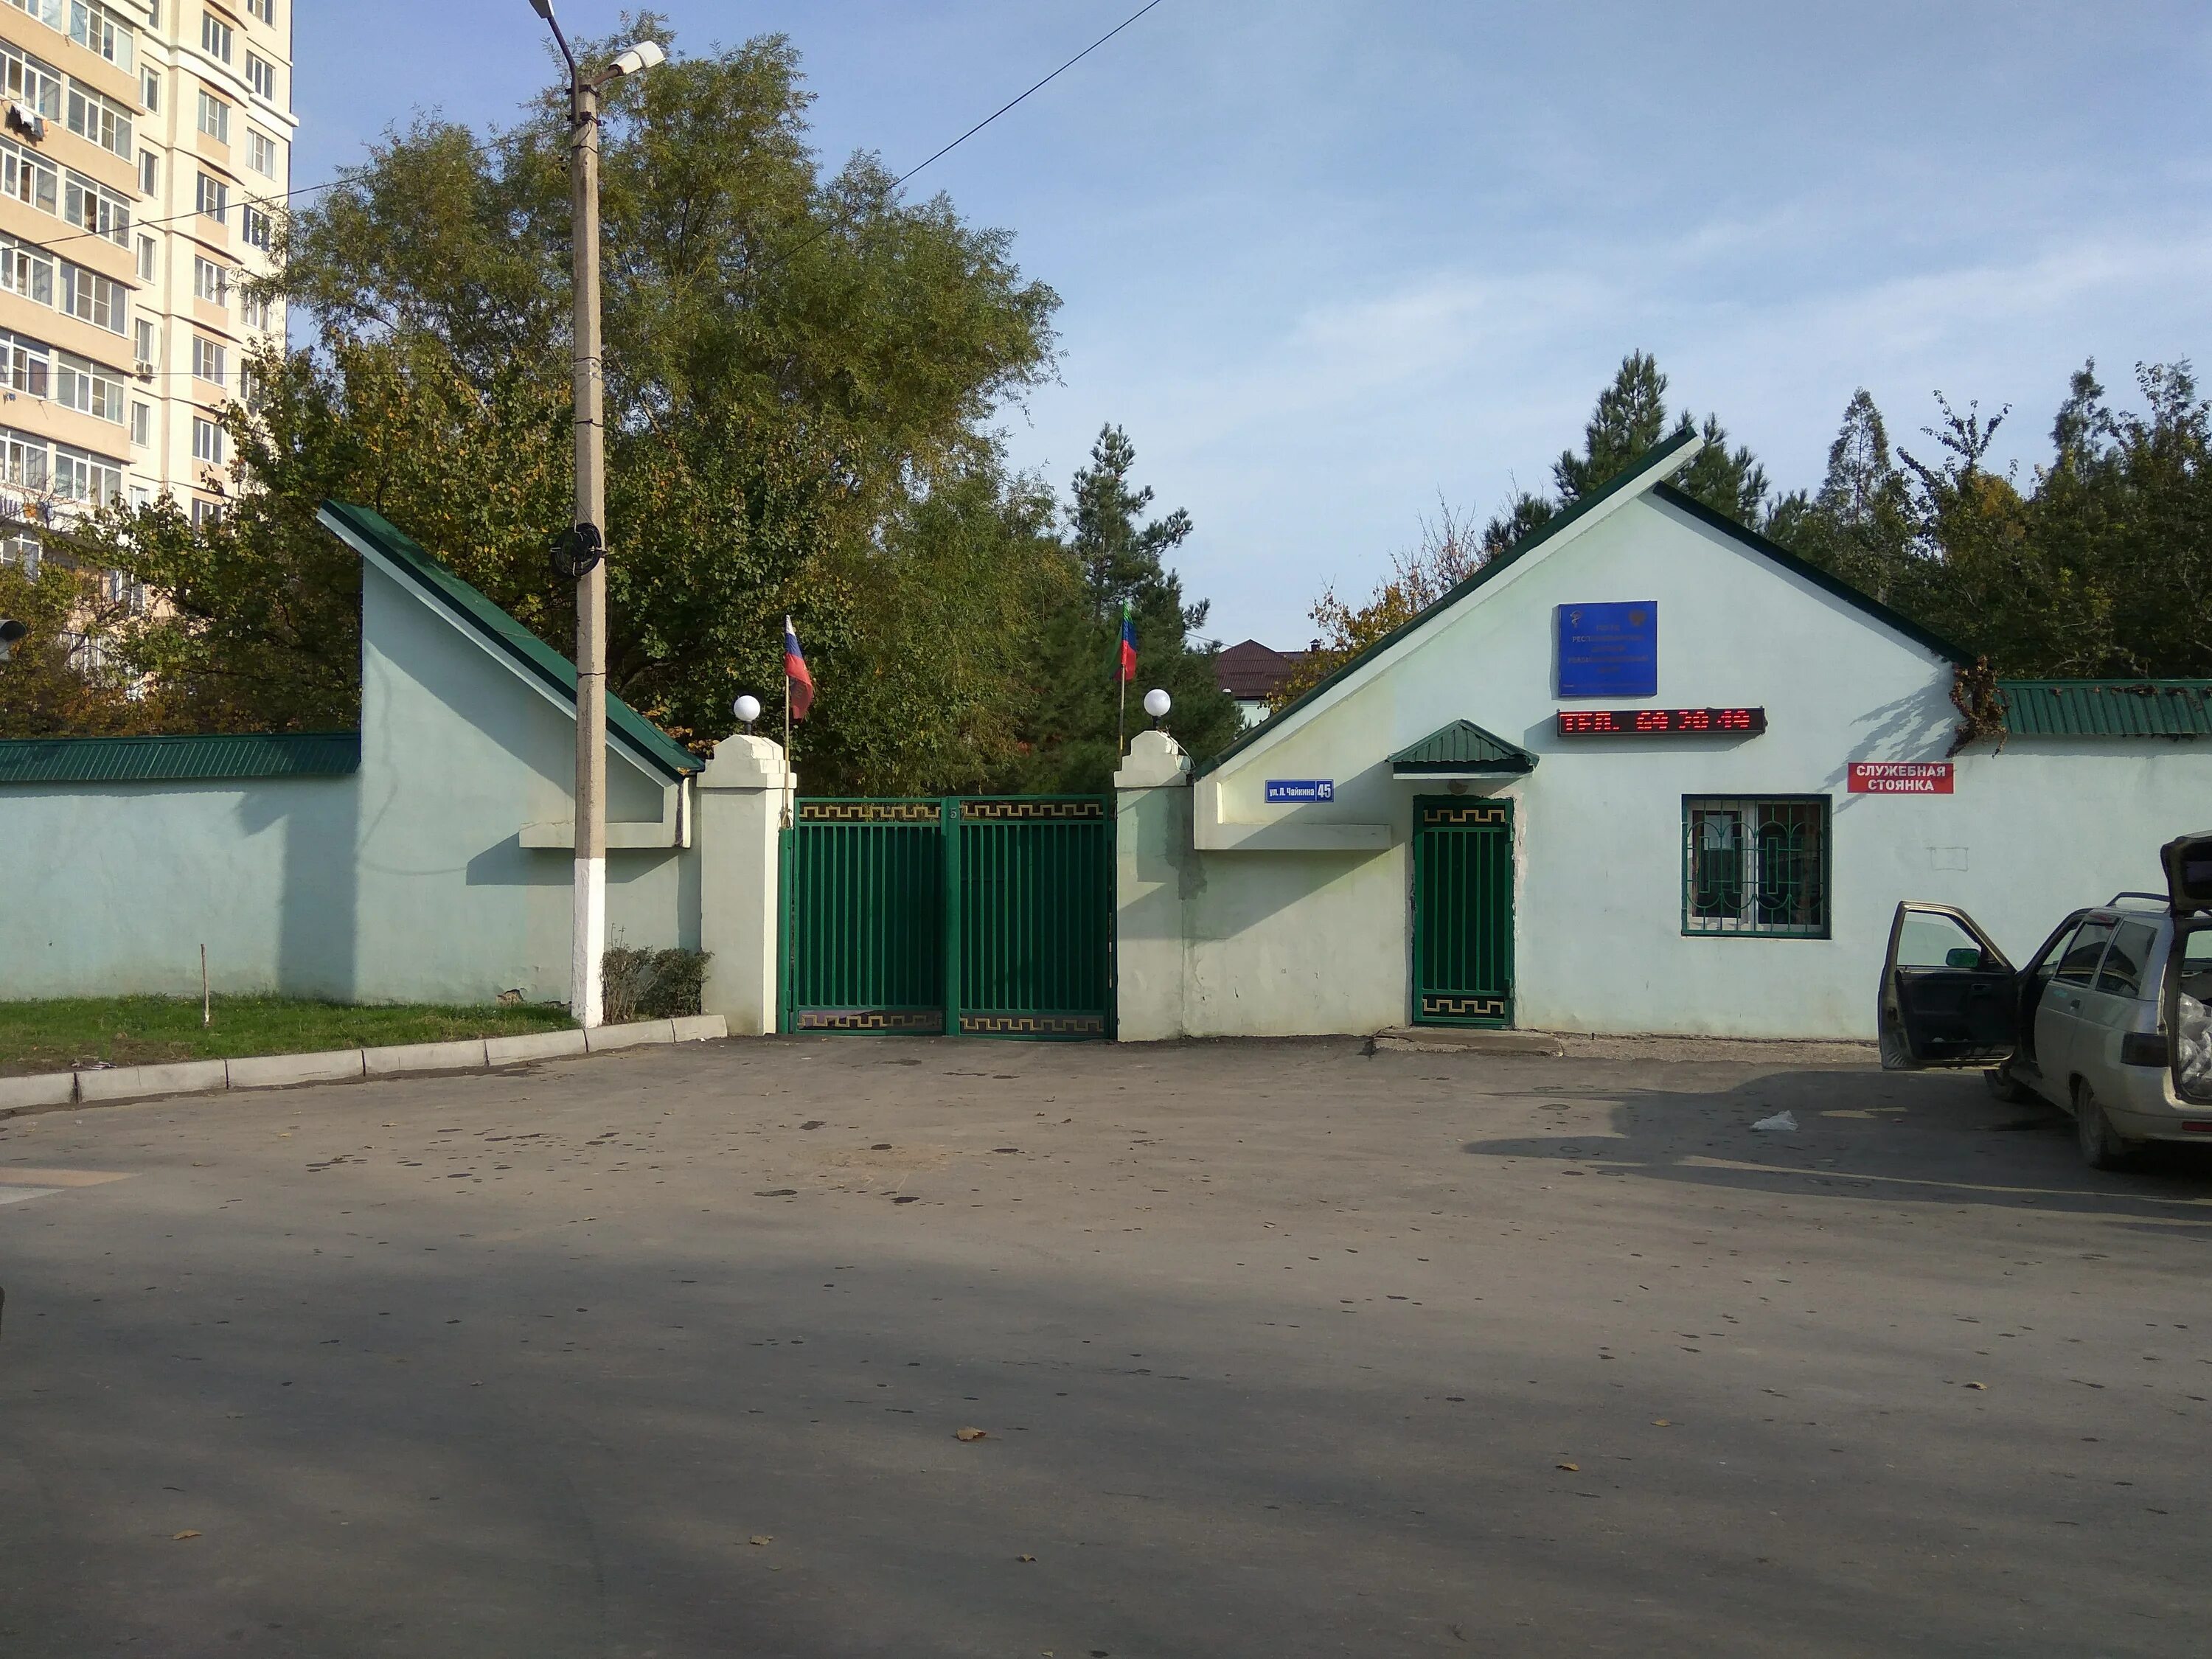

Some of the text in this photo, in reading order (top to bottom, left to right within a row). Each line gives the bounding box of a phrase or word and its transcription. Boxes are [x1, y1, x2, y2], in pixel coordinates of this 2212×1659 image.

[1857, 765, 1945, 776] СЛУЖЕБНАЯ
[1868, 779, 1934, 790] СТОЯНКА
[1279, 787, 1286, 796] Л.
[1287, 787, 1315, 796] Чайкина
[1318, 784, 1331, 798] 45
